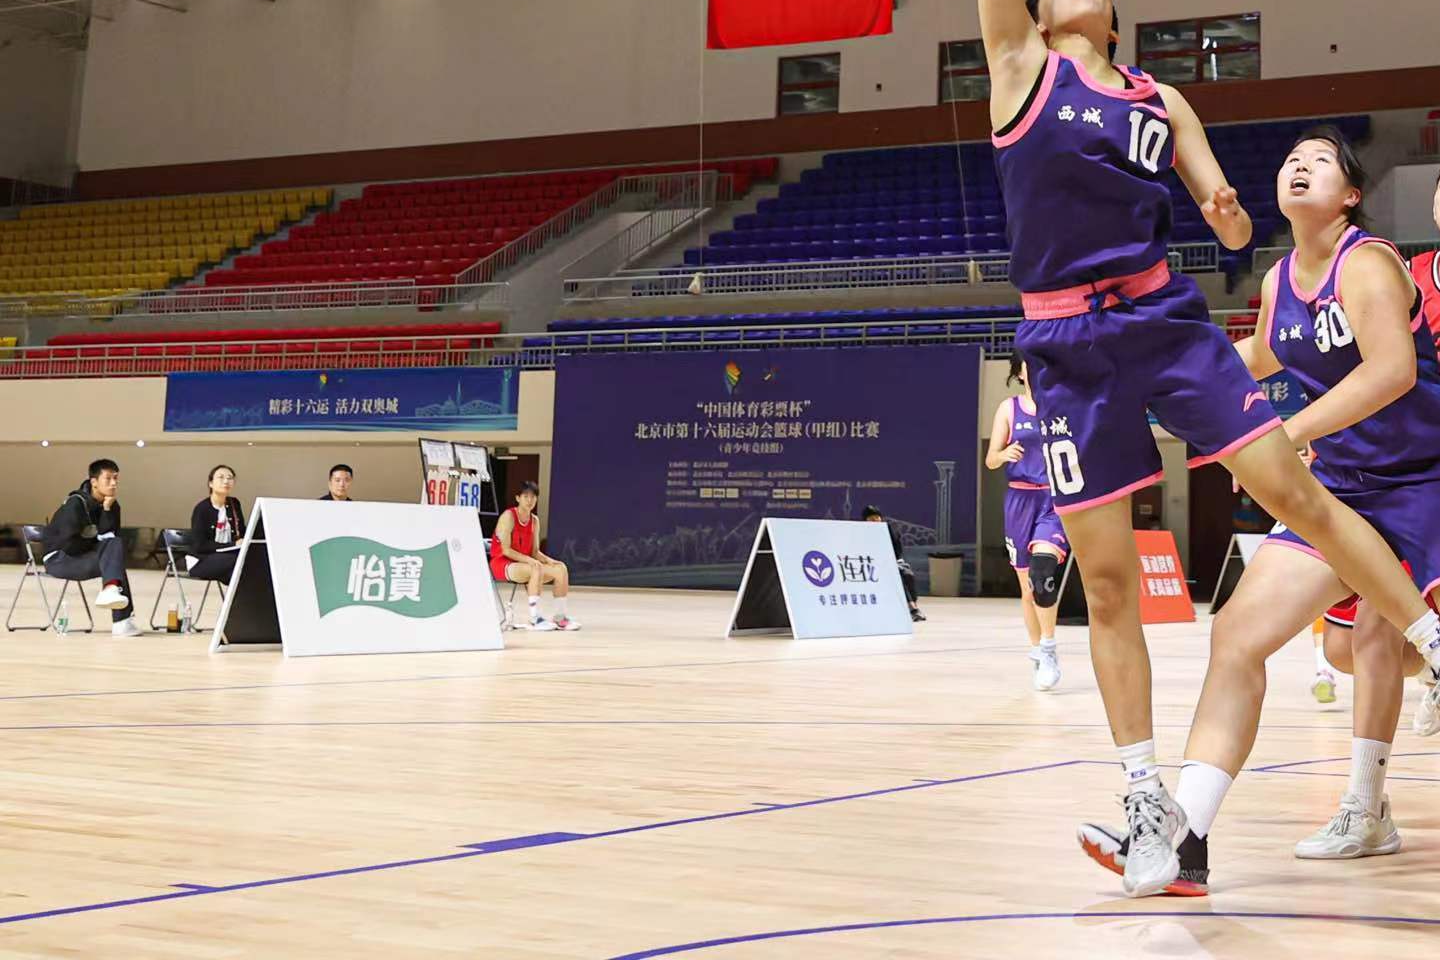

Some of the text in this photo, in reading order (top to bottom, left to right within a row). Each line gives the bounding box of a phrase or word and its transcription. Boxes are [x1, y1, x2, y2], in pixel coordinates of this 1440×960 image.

[1058, 105, 1104, 128] 西城
[1128, 110, 1169, 173] 10
[1314, 301, 1354, 353] 30
[269, 397, 399, 415] 精彩十六运 活力双奥城
[1042, 439, 1085, 497] 10
[461, 482, 480, 507] 58
[347, 554, 423, 602] 怡寶
